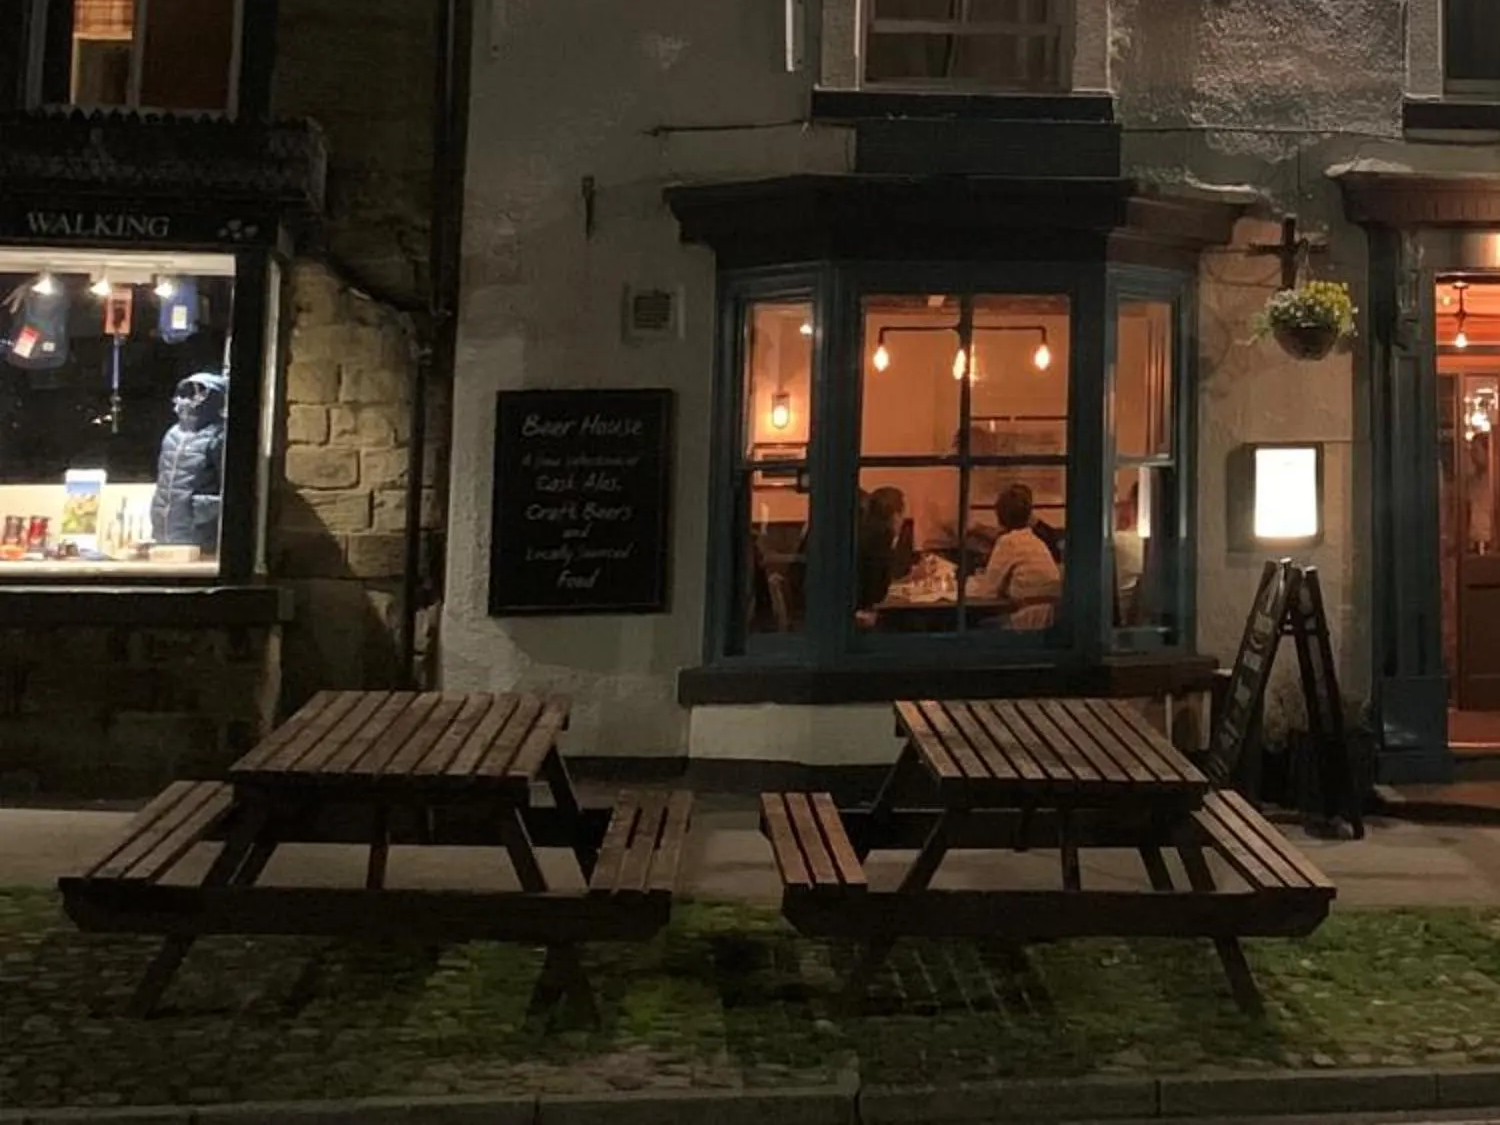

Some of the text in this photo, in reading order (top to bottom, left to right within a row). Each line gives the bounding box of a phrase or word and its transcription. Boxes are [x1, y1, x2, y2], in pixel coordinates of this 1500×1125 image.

[27, 211, 171, 238] WALKING
[521, 412, 643, 437] Beer House
[536, 472, 575, 493] Cask
[525, 501, 633, 523] Craft Beers
[563, 521, 593, 538] and
[557, 566, 601, 589] Food
